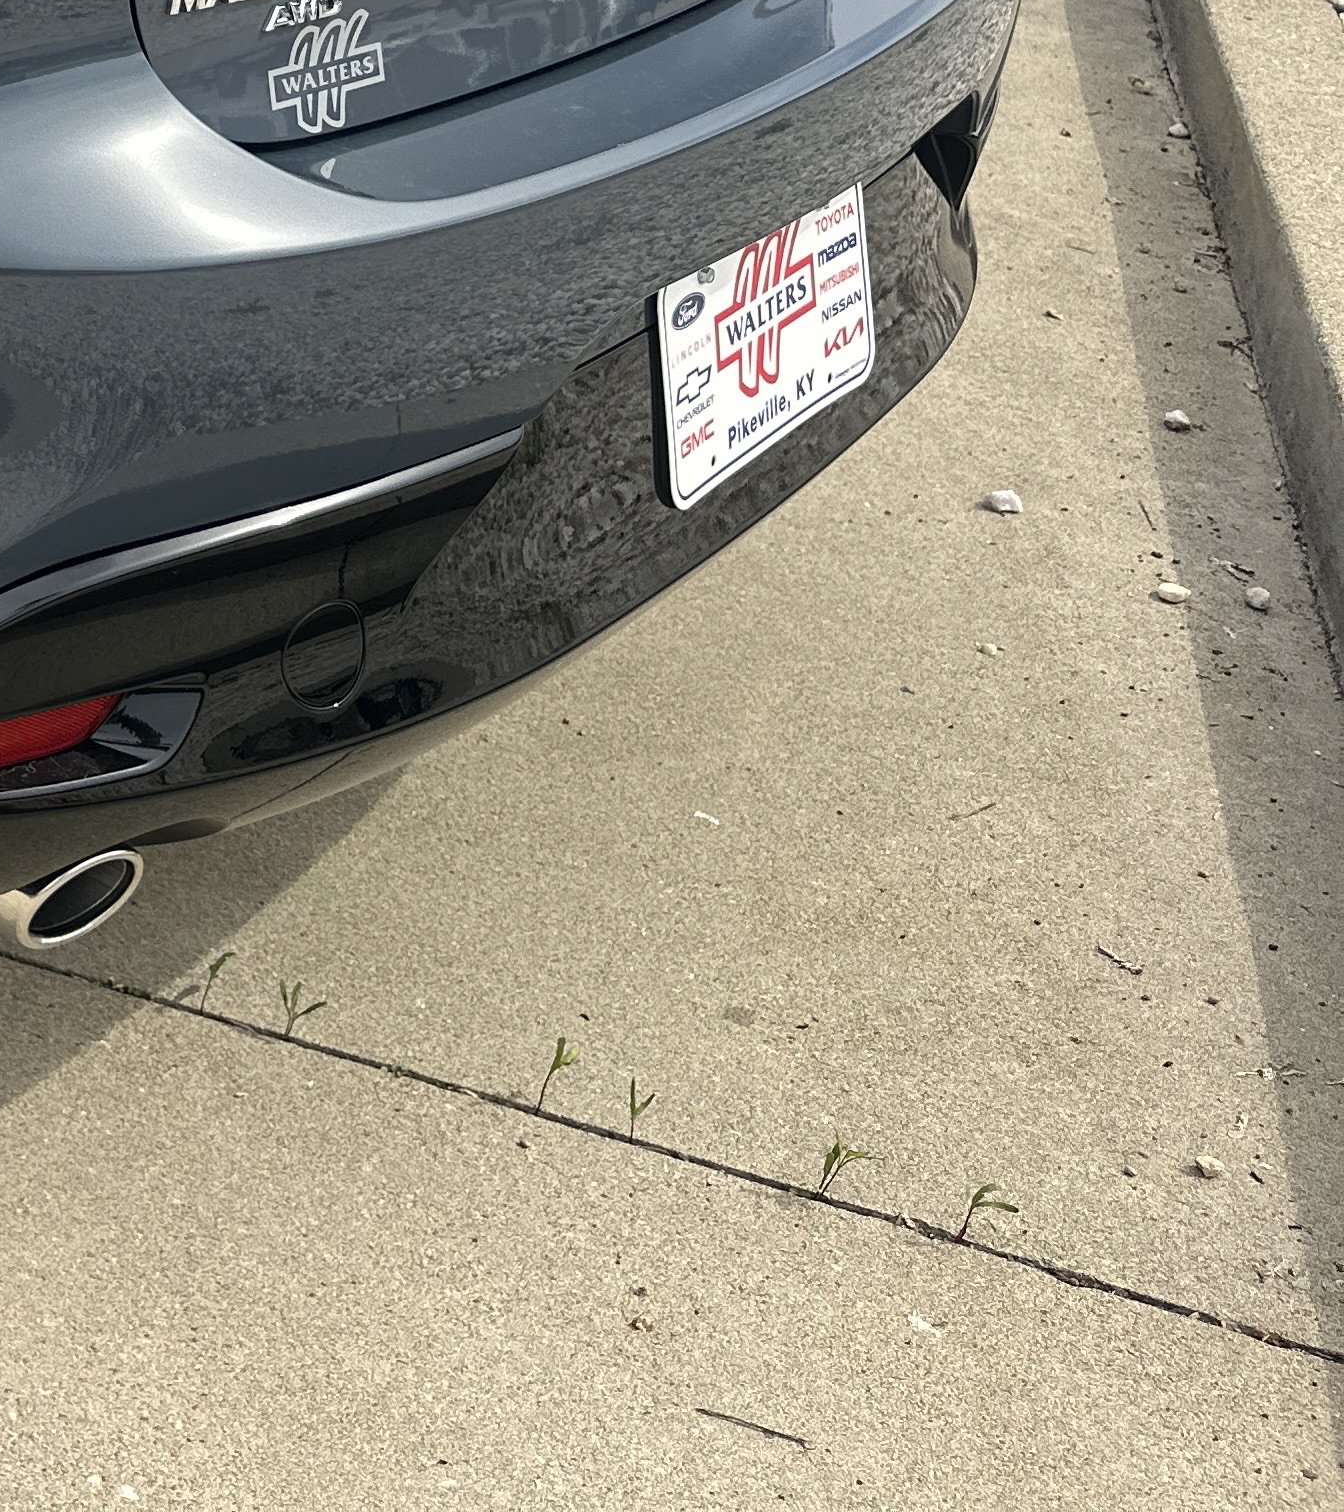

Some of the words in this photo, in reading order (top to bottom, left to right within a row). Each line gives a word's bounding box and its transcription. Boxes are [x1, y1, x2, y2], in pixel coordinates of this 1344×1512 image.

[281, 55, 375, 95] WALTERS
[815, 202, 854, 236] TOYOTA
[819, 261, 860, 296] MITSUBISHI
[725, 274, 807, 345] WALTERS
[821, 289, 862, 324] NISSAN
[671, 333, 712, 369] LINCOLN
[676, 394, 715, 430] CHEVROLET
[728, 394, 791, 450] Pikeville,
[796, 368, 815, 400] KY
[680, 418, 715, 459] GMC
